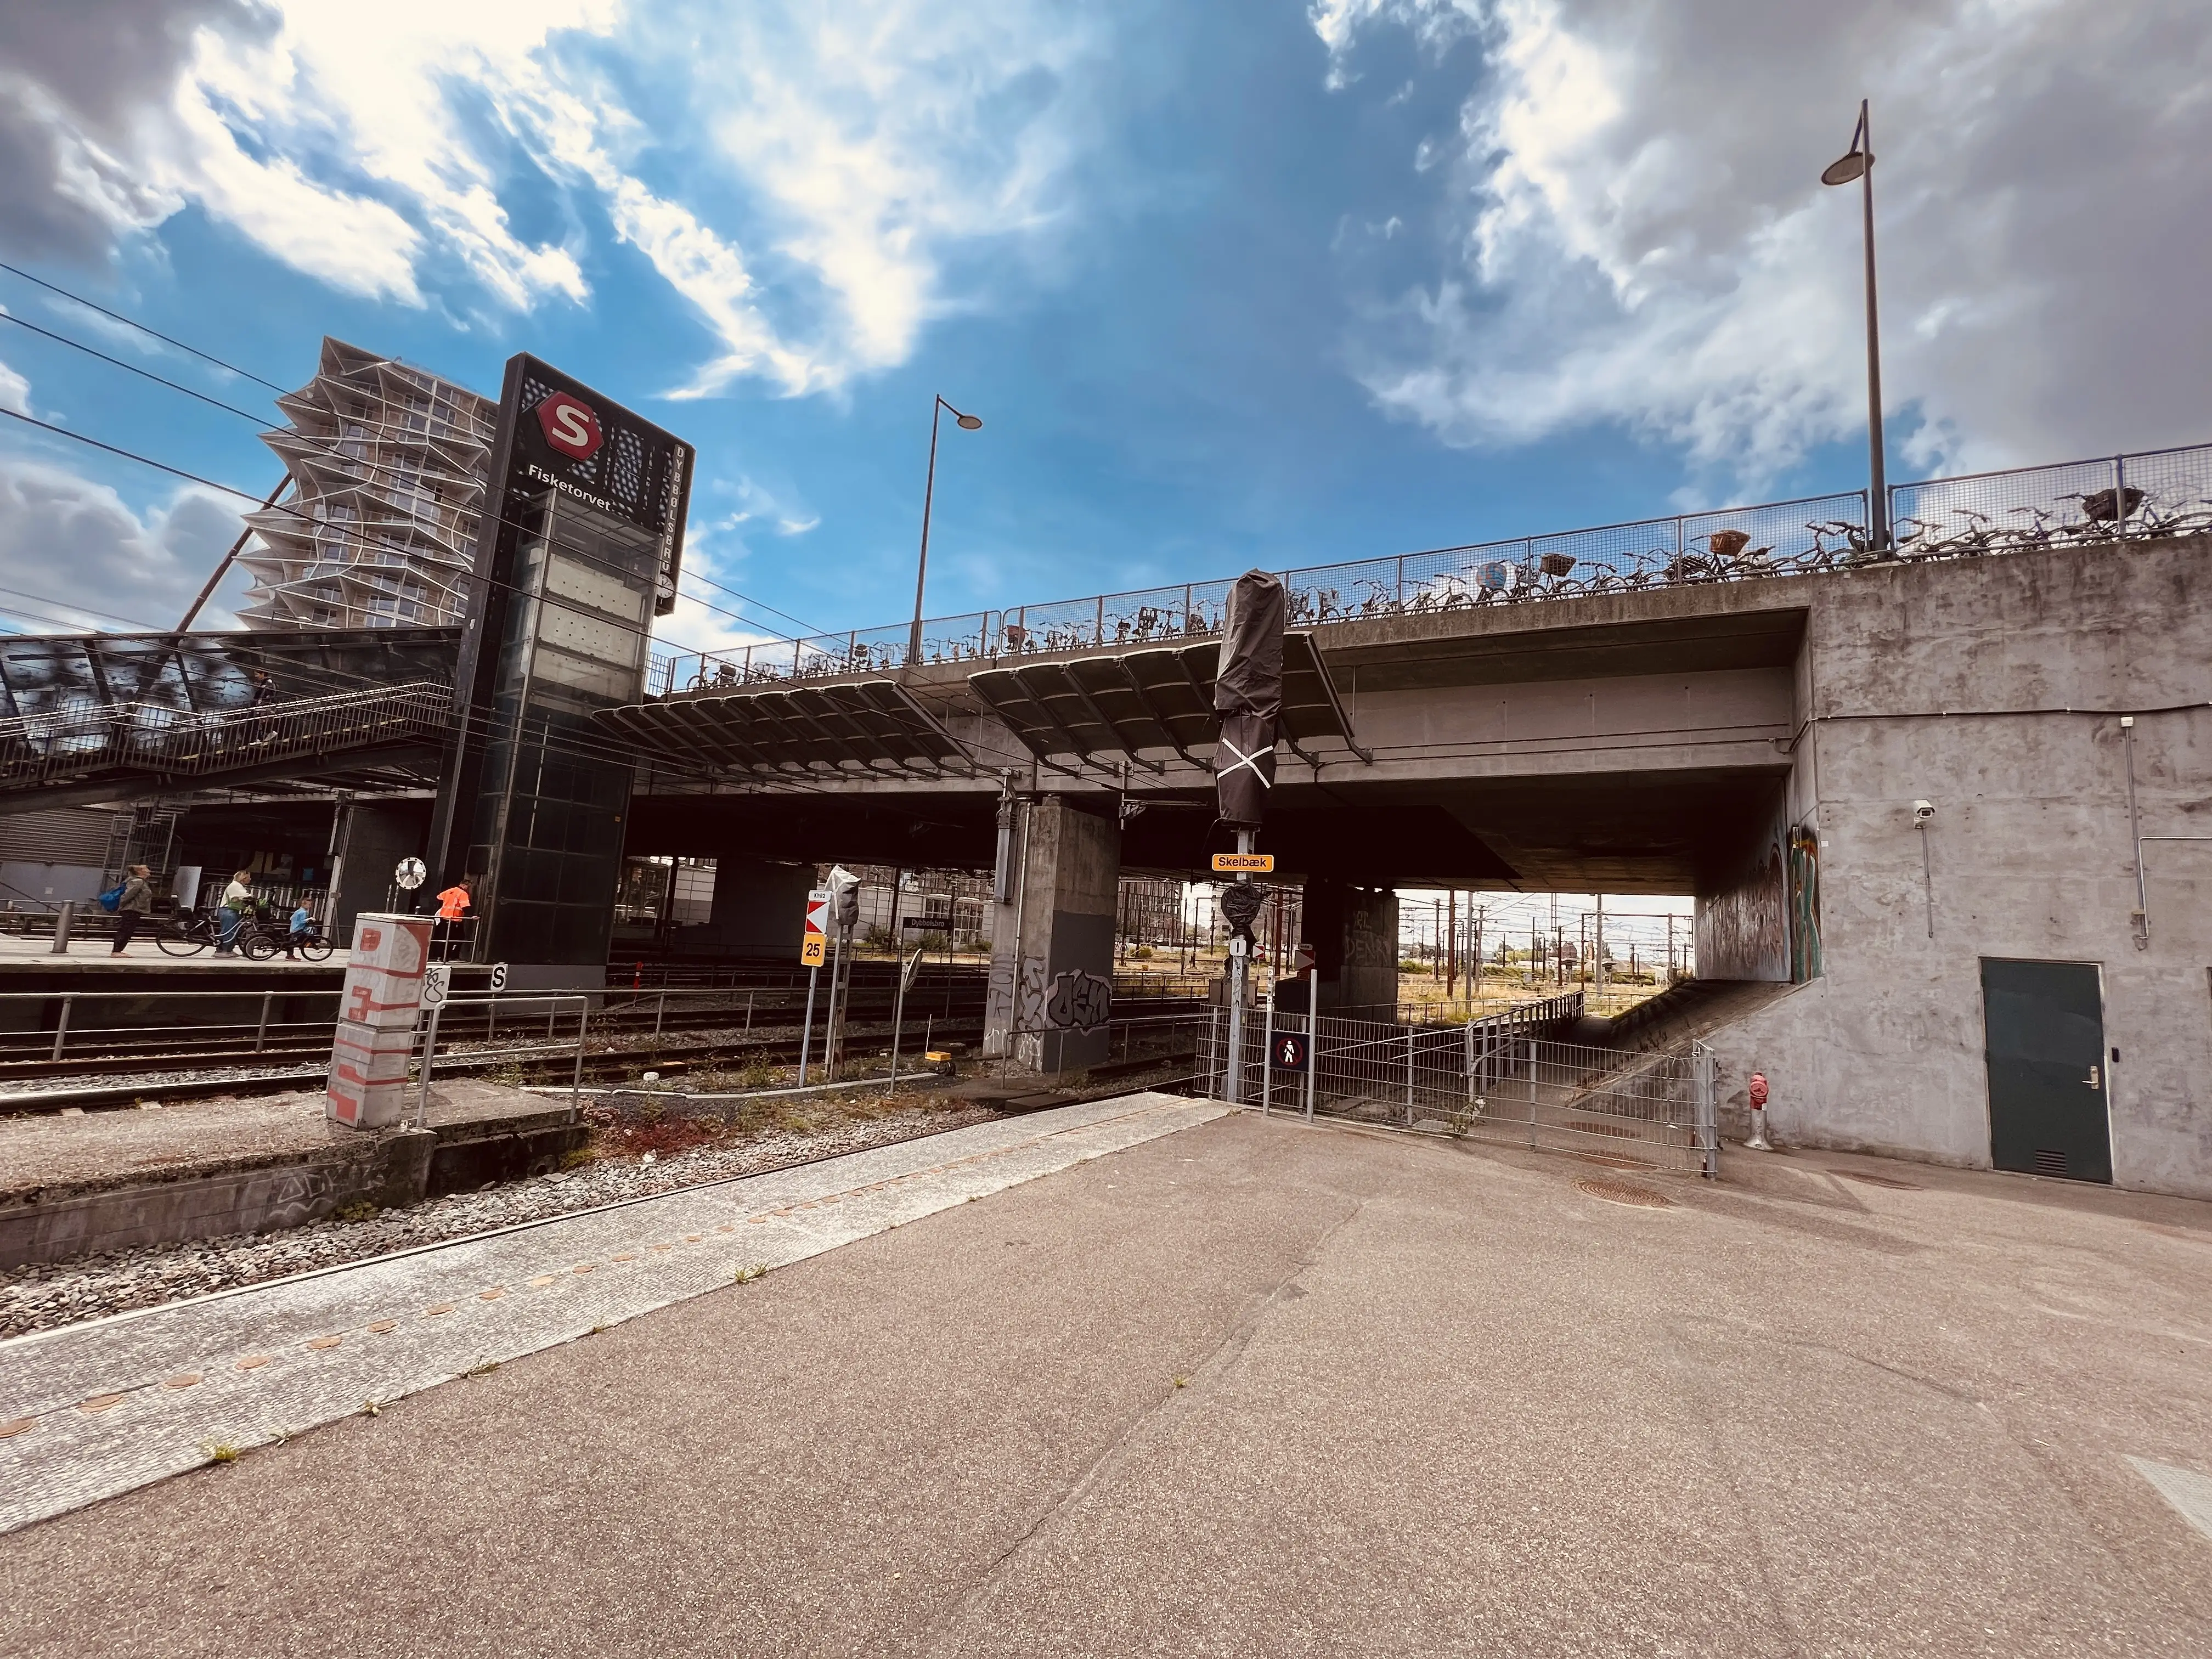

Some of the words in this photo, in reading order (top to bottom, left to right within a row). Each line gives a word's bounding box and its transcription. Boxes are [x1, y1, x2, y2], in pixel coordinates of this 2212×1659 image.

[552, 404, 589, 447] S
[528, 464, 611, 511] Fisketorvet
[1218, 856, 1267, 867] Skelbæk
[805, 943, 821, 957] 25
[492, 966, 505, 988] S
